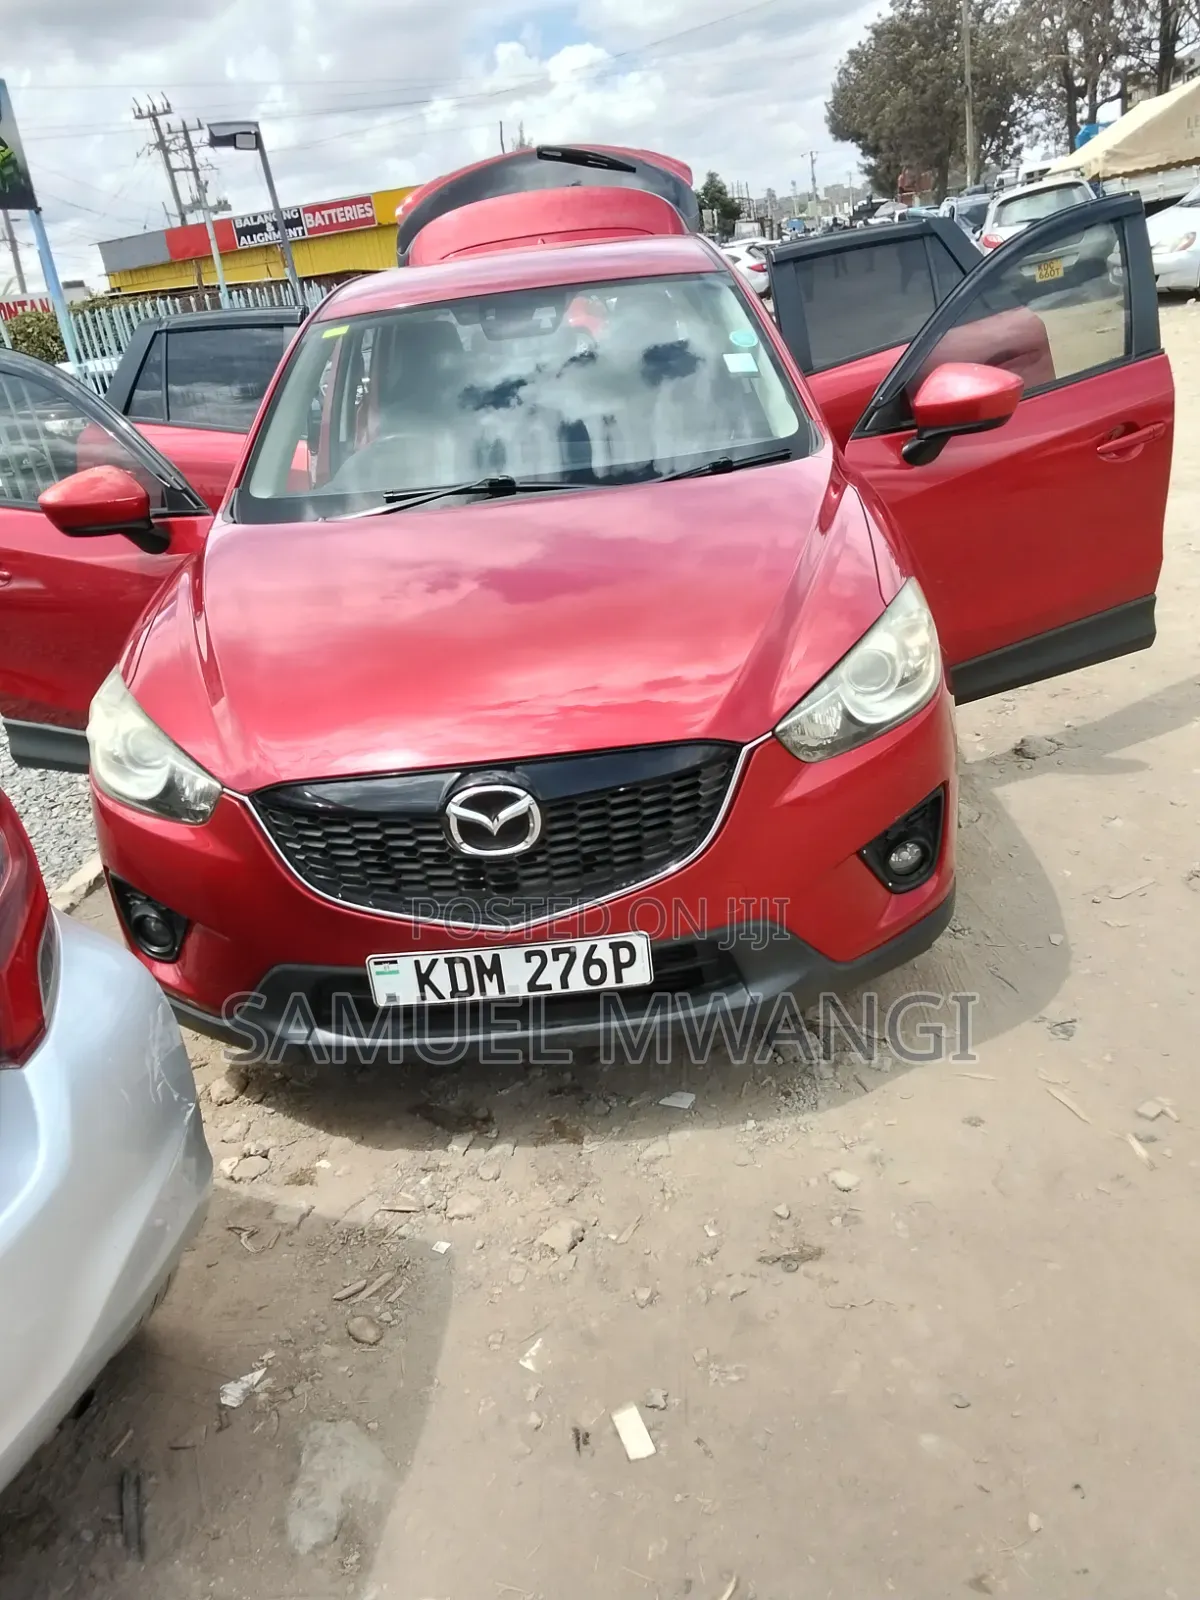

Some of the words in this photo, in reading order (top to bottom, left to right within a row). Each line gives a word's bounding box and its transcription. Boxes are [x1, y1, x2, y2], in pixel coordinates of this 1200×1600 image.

[235, 208, 299, 229] BALANCNG
[304, 202, 374, 228] BATTERIES
[265, 222, 275, 232] &
[414, 953, 506, 1001] KDM
[524, 940, 637, 993] 276P
